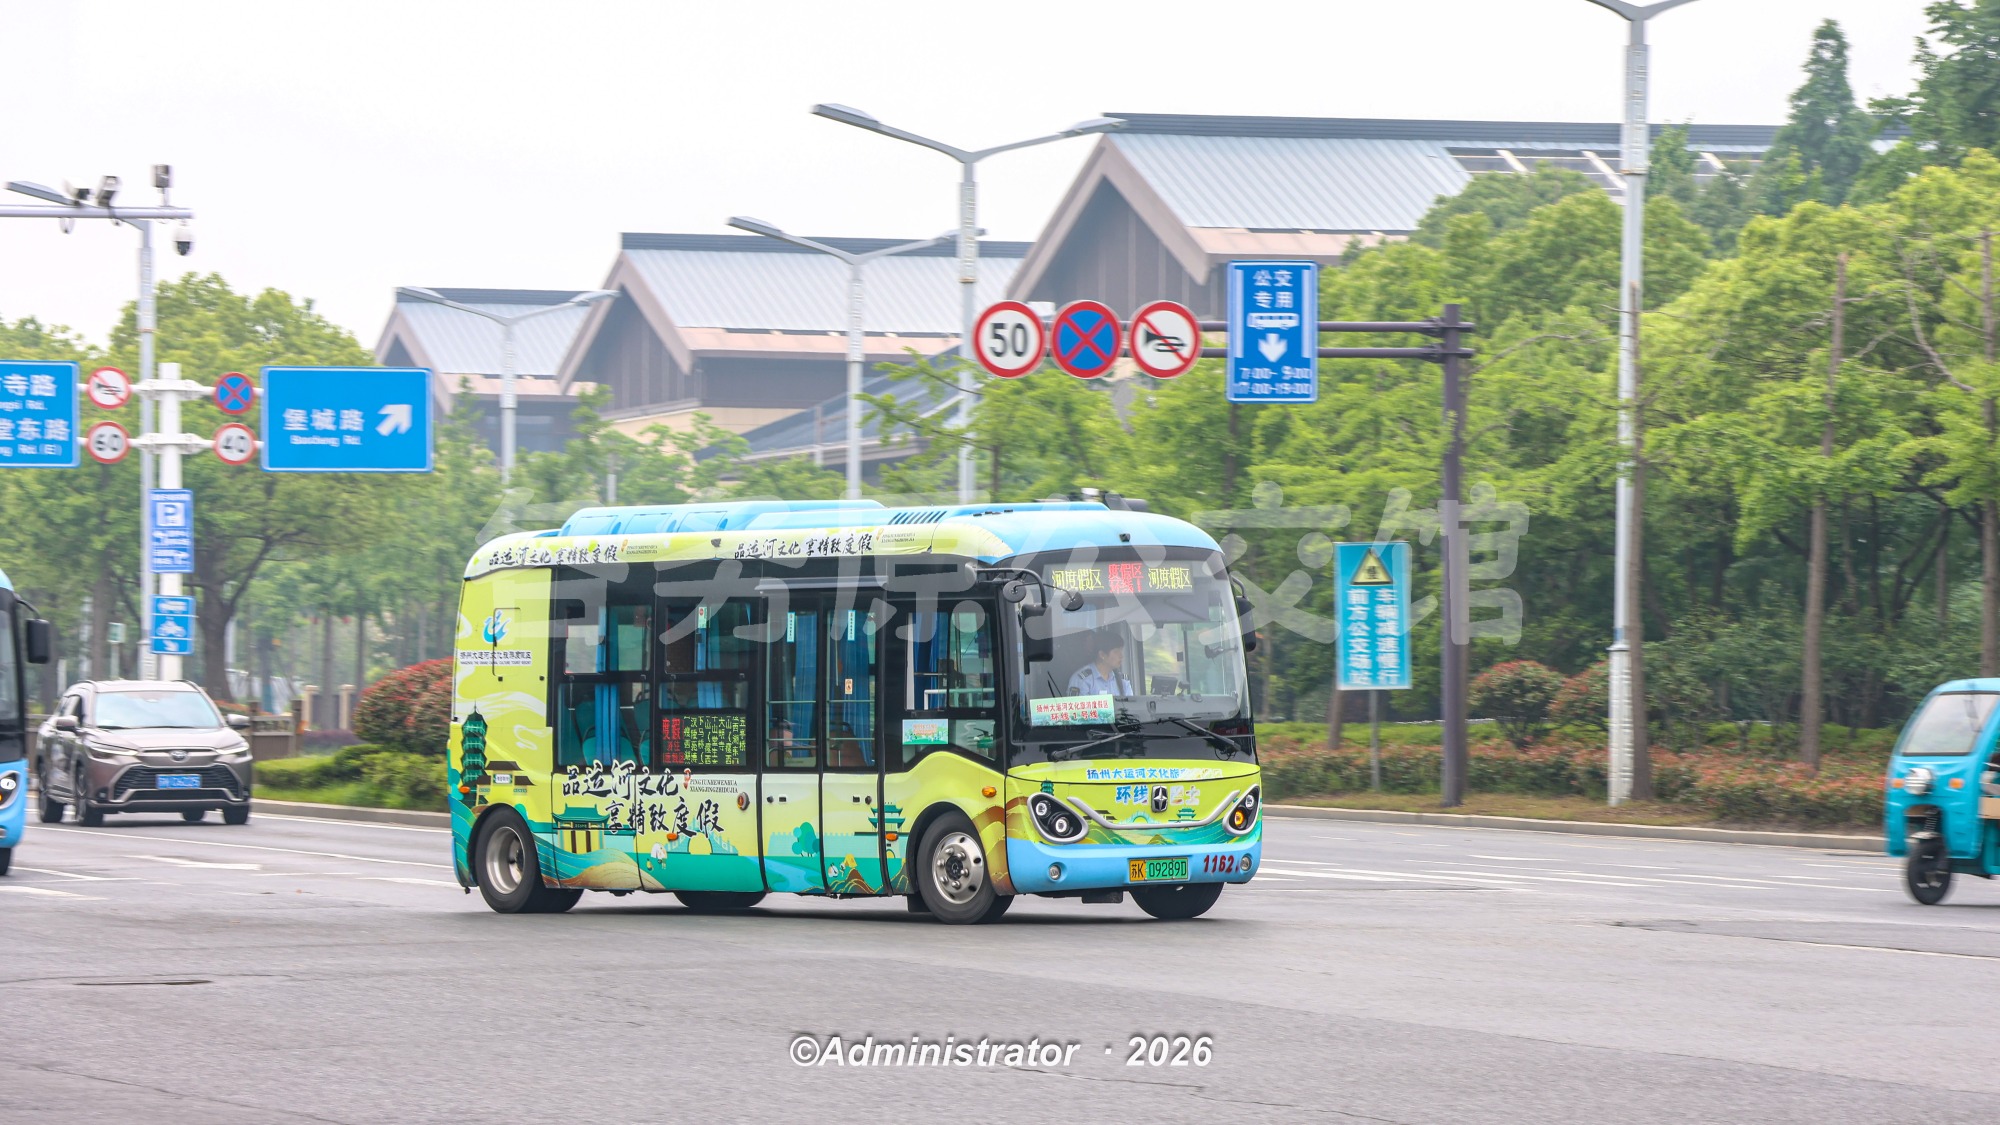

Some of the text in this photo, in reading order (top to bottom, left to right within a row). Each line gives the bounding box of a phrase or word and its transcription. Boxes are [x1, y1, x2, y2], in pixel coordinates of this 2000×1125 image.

[1253, 269, 1293, 287] 公交
[1253, 291, 1293, 308] 专用
[990, 323, 1028, 357] 50
[0, 373, 57, 397] 寺路
[283, 408, 365, 431] 堡城路
[563, 761, 679, 799] 品运河文化
[605, 797, 725, 838] 享精致度假
